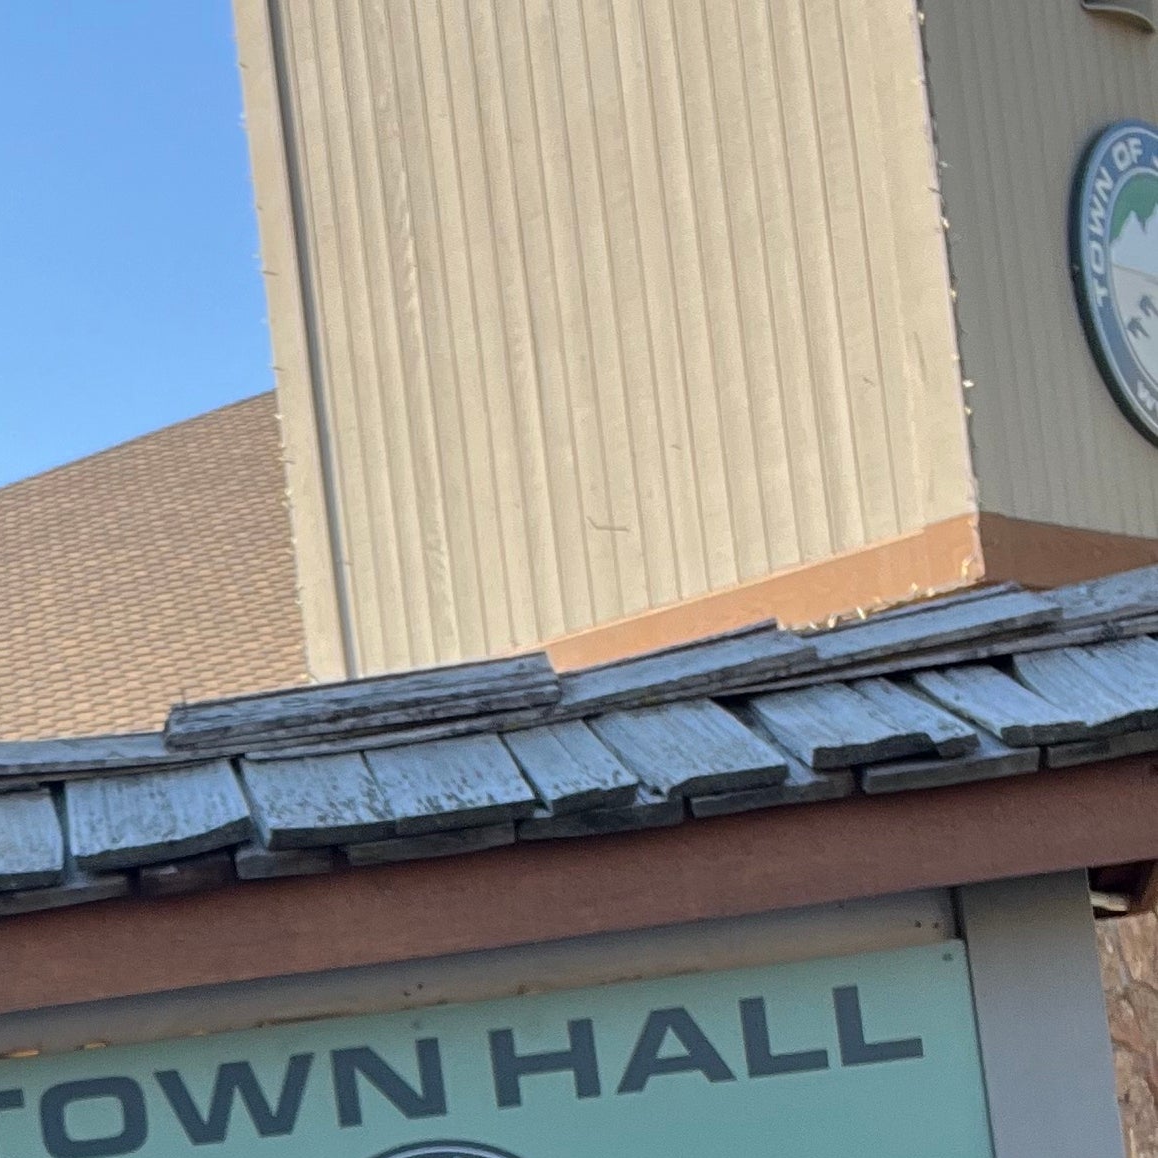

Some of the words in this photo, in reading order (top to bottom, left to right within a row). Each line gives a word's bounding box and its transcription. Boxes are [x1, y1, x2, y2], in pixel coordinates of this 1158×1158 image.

[1088, 166, 1114, 307] TOWN
[1111, 137, 1143, 170] OF
[487, 984, 925, 1110] HALL
